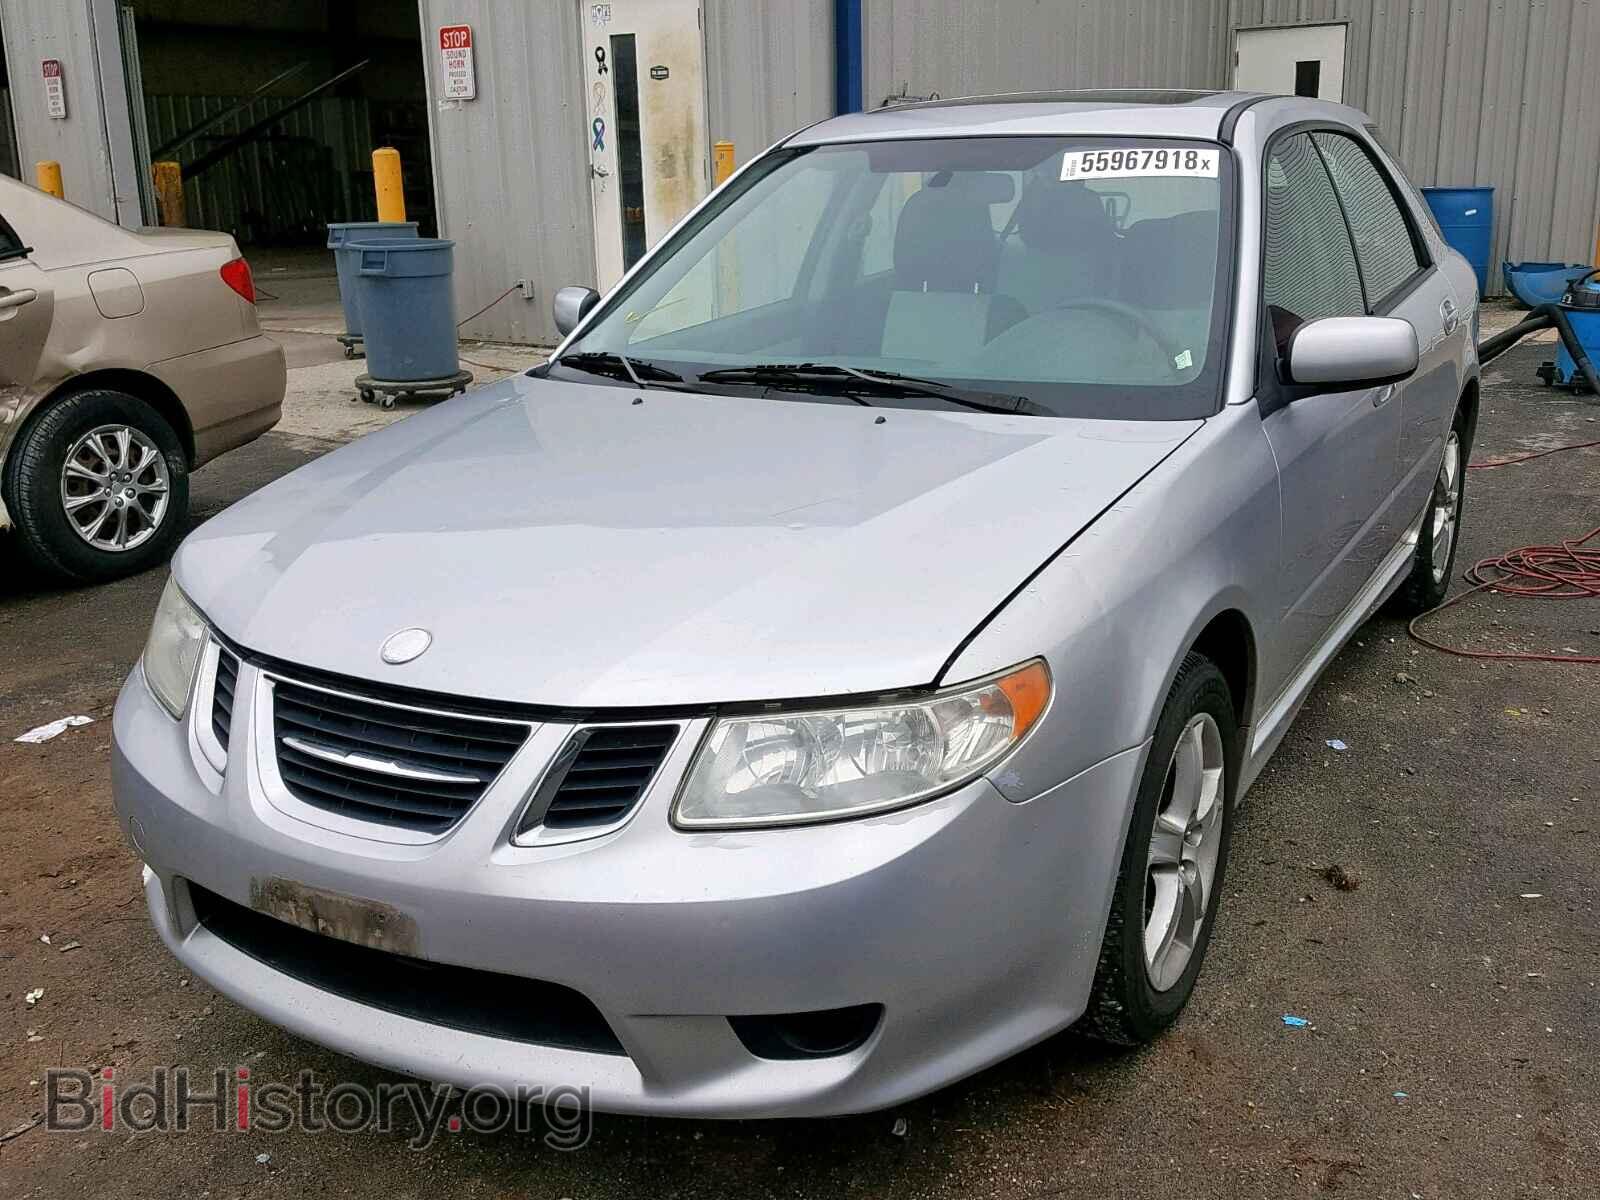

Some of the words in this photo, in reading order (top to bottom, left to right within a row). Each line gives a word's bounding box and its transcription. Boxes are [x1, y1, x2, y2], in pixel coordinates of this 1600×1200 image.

[443, 31, 467, 48] STOP
[446, 50, 466, 59] SOUND
[44, 63, 58, 77] STOP
[448, 60, 465, 69] HORN
